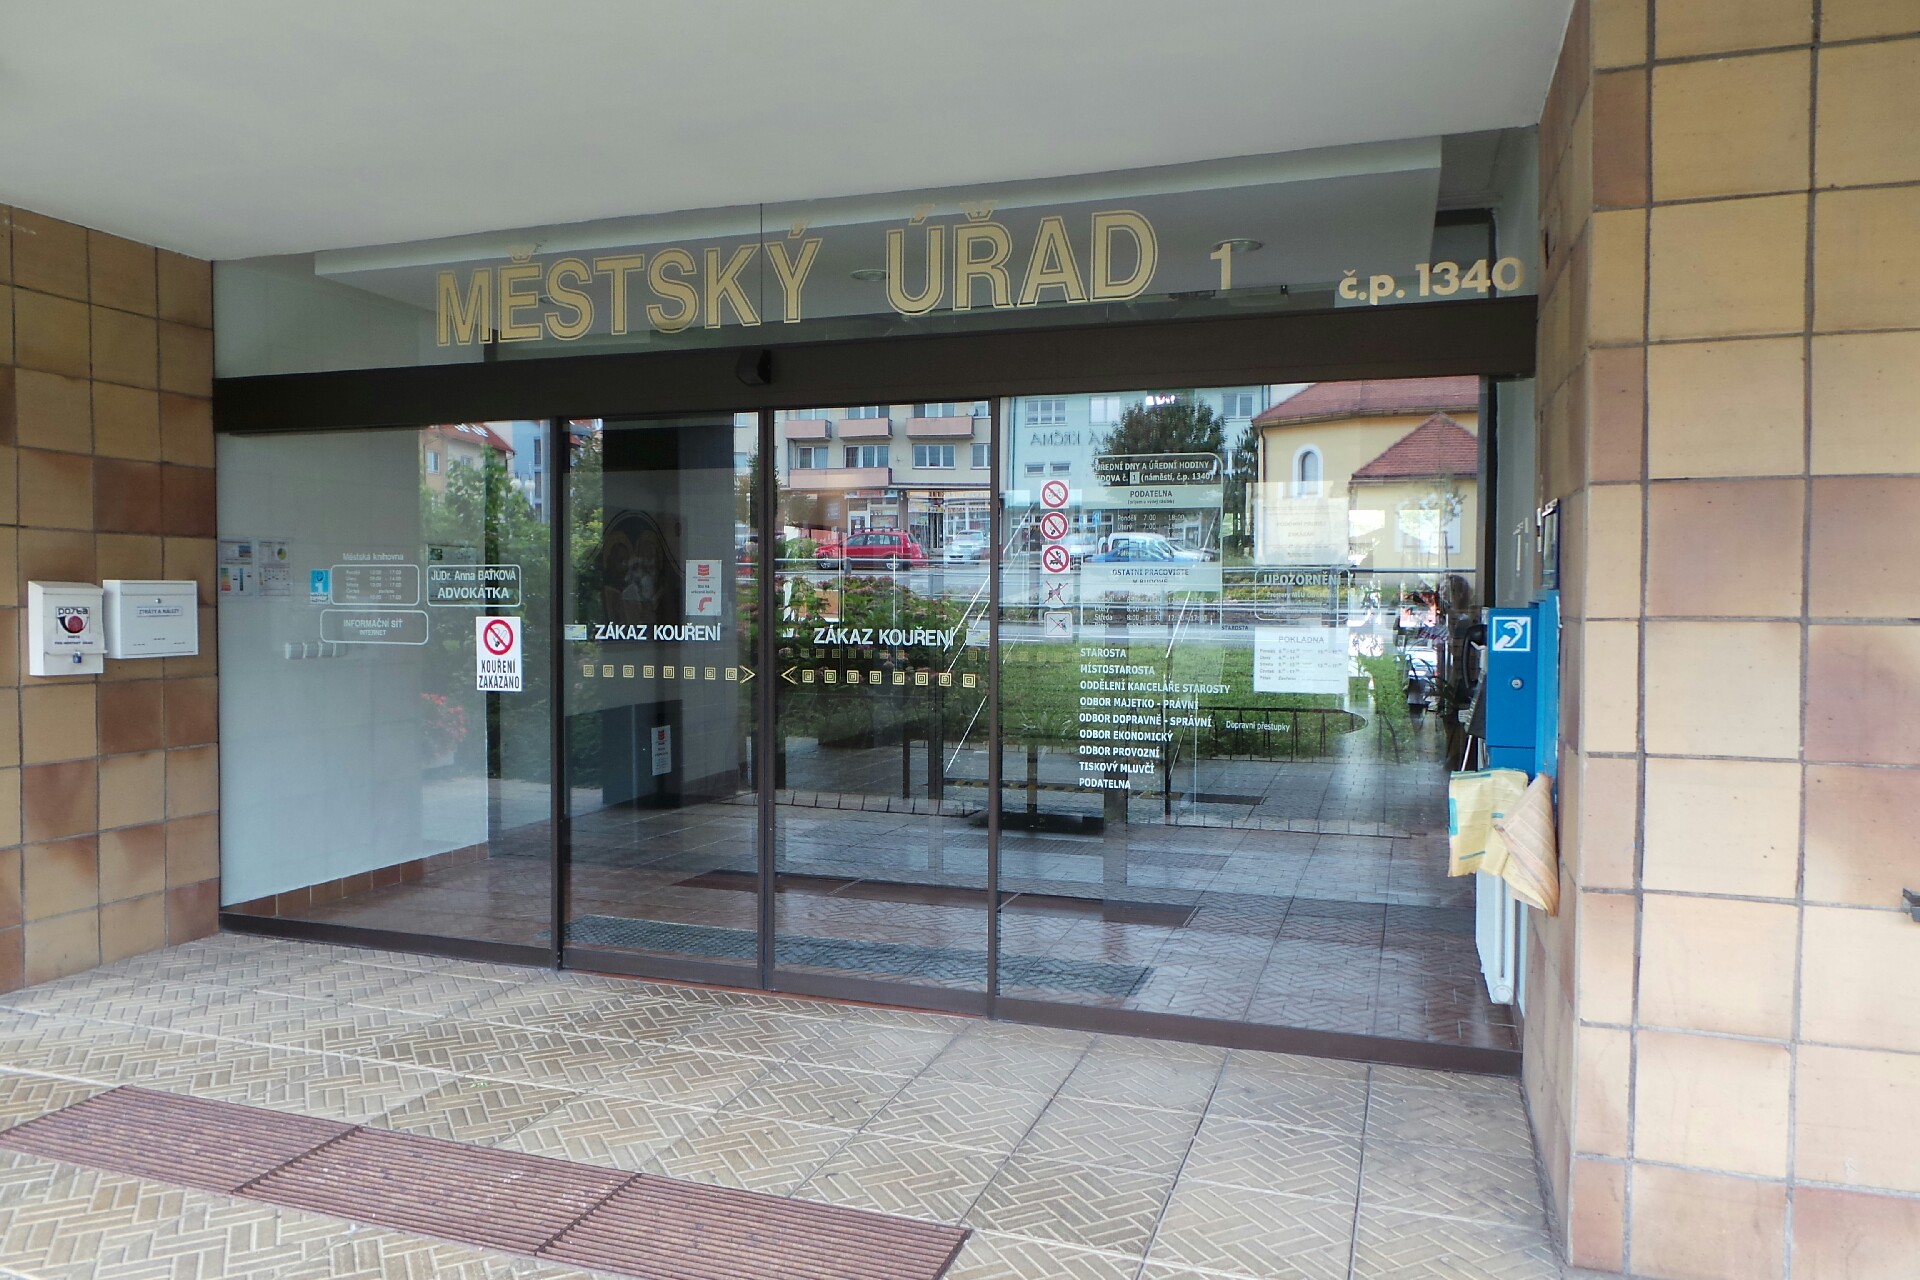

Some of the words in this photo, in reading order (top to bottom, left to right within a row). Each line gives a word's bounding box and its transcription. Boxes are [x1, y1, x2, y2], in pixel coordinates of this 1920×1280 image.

[436, 221, 823, 347] MĚSTSKÝ
[886, 201, 1158, 315] ÚŘAD
[1210, 243, 1232, 290] 1
[1339, 269, 1405, 305] č.p.
[1415, 257, 1524, 297] 1340
[1124, 462, 1140, 471] DNY
[1179, 461, 1210, 470] HODINY
[1130, 490, 1173, 498] PODATELNA
[455, 571, 475, 580] Anna
[438, 584, 510, 599] ADVOKÁTKA
[344, 618, 389, 628] INFORMAČNÍ
[594, 621, 648, 640] ZÁKAZ
[654, 622, 721, 641] KOUŘENÍ
[814, 625, 874, 644] ZÁKAZ
[879, 626, 954, 646] KOUŘENÍ
[1278, 636, 1324, 644] POKLADNA
[1080, 648, 1126, 658] STAROSTA
[481, 659, 515, 674] KOUŘENÍ
[1080, 662, 1155, 675] MÍSTOSTAROSTA
[1080, 679, 1126, 691] ODDĚLENÍ
[1128, 679, 1180, 693] KANCELÁŘE
[1182, 684, 1231, 694] STAROSTY
[1080, 697, 1111, 707] ODBOR
[1113, 698, 1155, 709] MAJETKO
[1163, 698, 1199, 710] PRÁVNÍ
[1079, 713, 1110, 723] ODBOR
[1112, 714, 1162, 725] DOPRAVNĚ
[1170, 715, 1212, 728] SPRÁVNÍ
[1079, 729, 1111, 740] ODBOR
[1113, 729, 1173, 742] EKONOMICKÝ
[1079, 745, 1111, 756] ODBOR
[1113, 746, 1160, 758] PROVOZNÍ
[1079, 760, 1118, 772] TISKOVÝ
[1120, 762, 1155, 774] MLUVČÍ
[1079, 777, 1131, 790] PODATELNA
